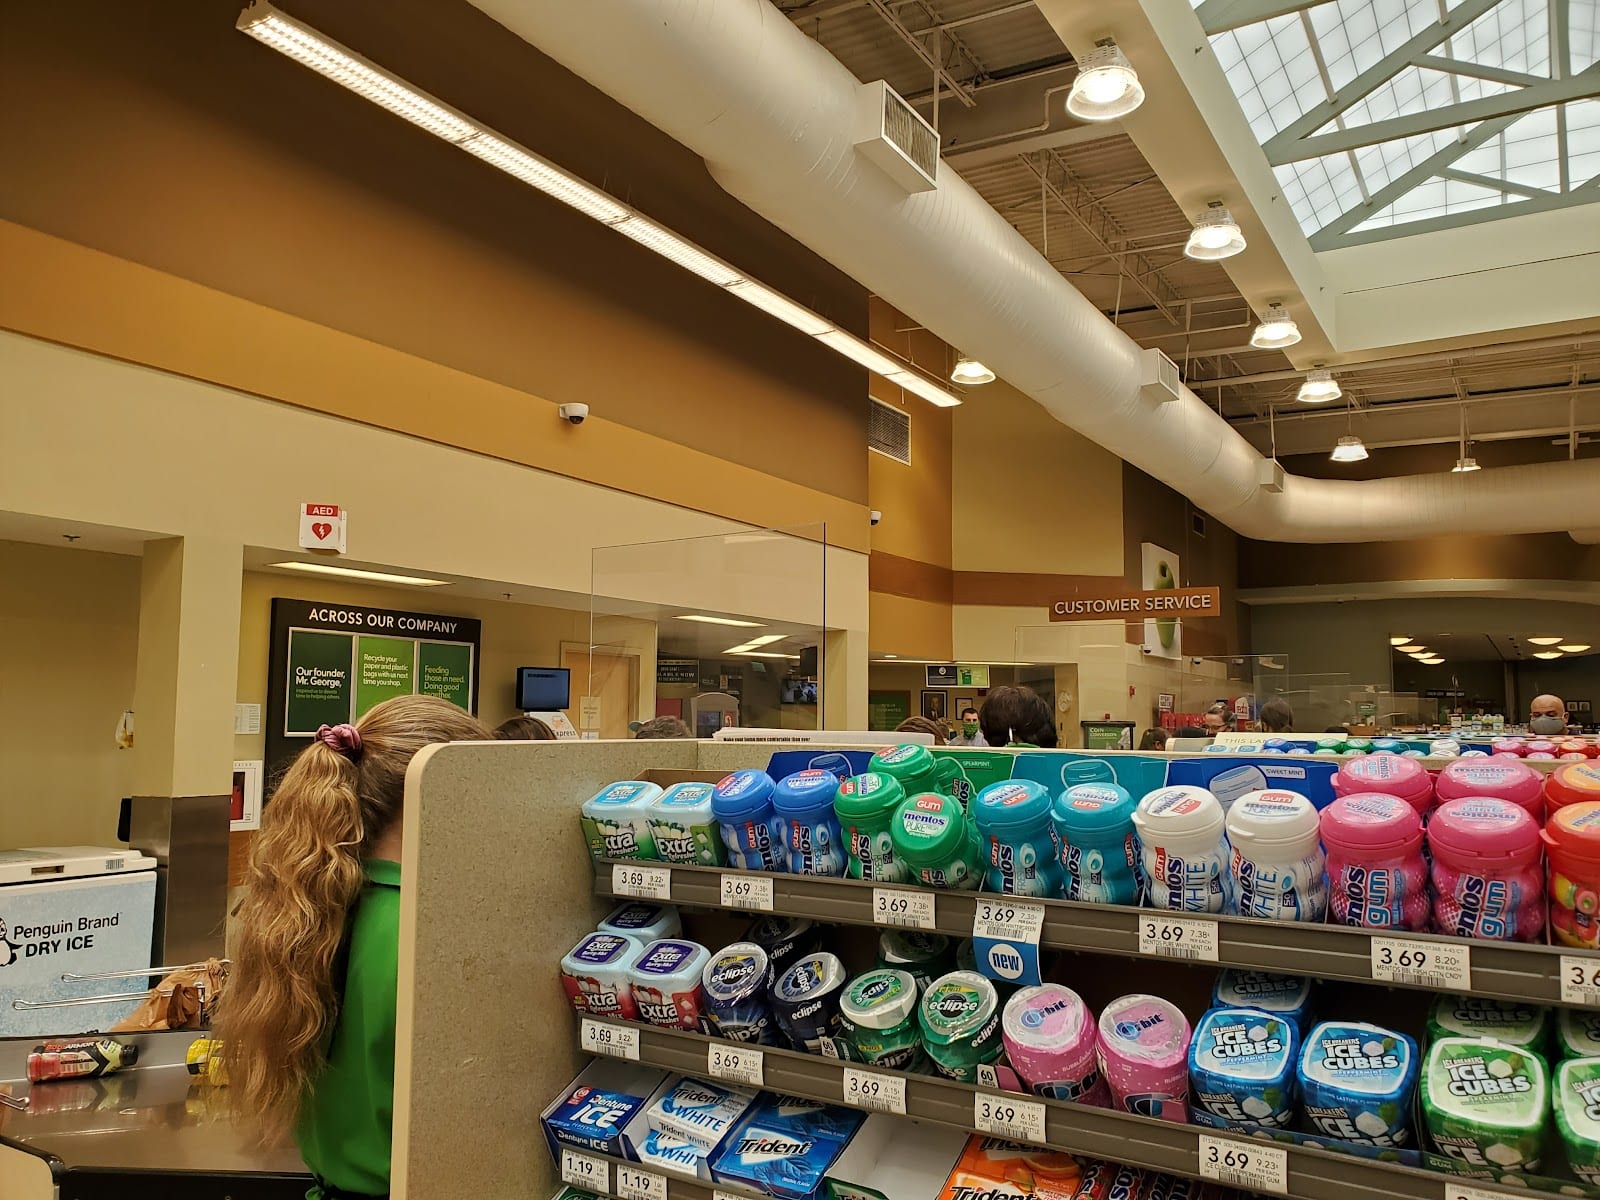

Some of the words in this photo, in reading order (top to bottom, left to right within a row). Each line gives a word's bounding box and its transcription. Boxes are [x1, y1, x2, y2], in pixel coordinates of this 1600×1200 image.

[312, 506, 334, 516] AED
[1054, 597, 1140, 615] CUSTOMER
[1144, 593, 1212, 611] SERVICE
[309, 608, 363, 625] ACROSS
[366, 613, 394, 628] OUR
[398, 617, 458, 634] COMPANY
[364, 654, 385, 663] Recycle
[385, 656, 398, 664] your
[364, 663, 379, 671] paper
[392, 664, 409, 672] plastic
[296, 667, 313, 677] Our
[313, 667, 346, 679] founder,
[364, 671, 377, 679] bags
[425, 666, 449, 676] Feeding
[296, 676, 309, 686] Mr.
[310, 677, 342, 689] George,
[424, 682, 443, 691] Doing
[443, 683, 460, 692] good
[962, 760, 991, 768] SPEARMINT
[916, 800, 941, 811] Gum
[904, 812, 945, 826] mentos
[906, 821, 925, 833] PURE
[1155, 855, 1165, 880] Gum
[622, 872, 643, 885] 3.69
[879, 897, 907, 912] 3.69
[1367, 868, 1391, 927] gum
[982, 906, 1014, 923] 3.69
[1456, 875, 1485, 938] entos
[1481, 880, 1506, 939] gum
[14, 919, 72, 940] Penguin
[78, 912, 119, 931] Brand
[1146, 923, 1184, 942] 3.69
[26, 939, 61, 957] DRY
[67, 935, 94, 951] ICE
[587, 942, 616, 951] Extra
[1142, 938, 1162, 948] MENTOS
[650, 952, 682, 962] Extra
[993, 953, 1020, 972] new
[1381, 948, 1427, 967] 3.69
[711, 965, 755, 983] eclipse
[796, 966, 810, 993] eclipse
[1376, 964, 1400, 973] MENTOS
[1445, 973, 1462, 981] CNDY
[1571, 966, 1600, 987] 3.6
[856, 976, 896, 1005] eclipse
[1233, 982, 1299, 995] CUBES
[589, 992, 617, 1006] xtra
[929, 999, 978, 1012] eclipse
[639, 1002, 678, 1022] Extra
[792, 1001, 822, 1020] eclipse
[1021, 1000, 1068, 1028] Orbit
[1454, 1009, 1533, 1022] CUBES
[590, 1027, 611, 1042] 3.69
[971, 1014, 999, 1048] eclipse
[1116, 1013, 1164, 1040] Orbit
[1214, 1030, 1248, 1045] ICE
[822, 1042, 833, 1051] 60
[1212, 1040, 1283, 1059] CUBES
[1326, 1045, 1362, 1058] ICE
[714, 1052, 739, 1069] 3.69
[1323, 1056, 1399, 1070] CUBES
[981, 1069, 992, 1081] 60
[1449, 1064, 1490, 1081] ICE
[850, 1078, 879, 1096] 3.69
[1448, 1076, 1533, 1096] CUBES
[588, 1094, 633, 1111] Dentyne
[672, 1088, 723, 1105] Trident
[569, 1103, 626, 1128] ICE
[677, 1105, 727, 1132] WHITE
[982, 1102, 1015, 1122] 3.69
[1205, 1102, 1242, 1121] ICE
[1195, 1115, 1213, 1126] GUM
[1313, 1117, 1360, 1138] ICE
[658, 1122, 685, 1138] Trident
[1022, 1126, 1039, 1134] BOTTLE
[557, 1130, 588, 1145] Dentyne
[589, 1138, 609, 1151] ICE
[737, 1138, 813, 1157] Trident
[1208, 1146, 1249, 1169] 3.69
[1440, 1142, 1489, 1166] ICE
[567, 1157, 593, 1175] 1.19
[1233, 1168, 1265, 1181] PEPPERMINT
[622, 1172, 650, 1190] 1.19
[949, 1187, 1040, 1200] Trident
